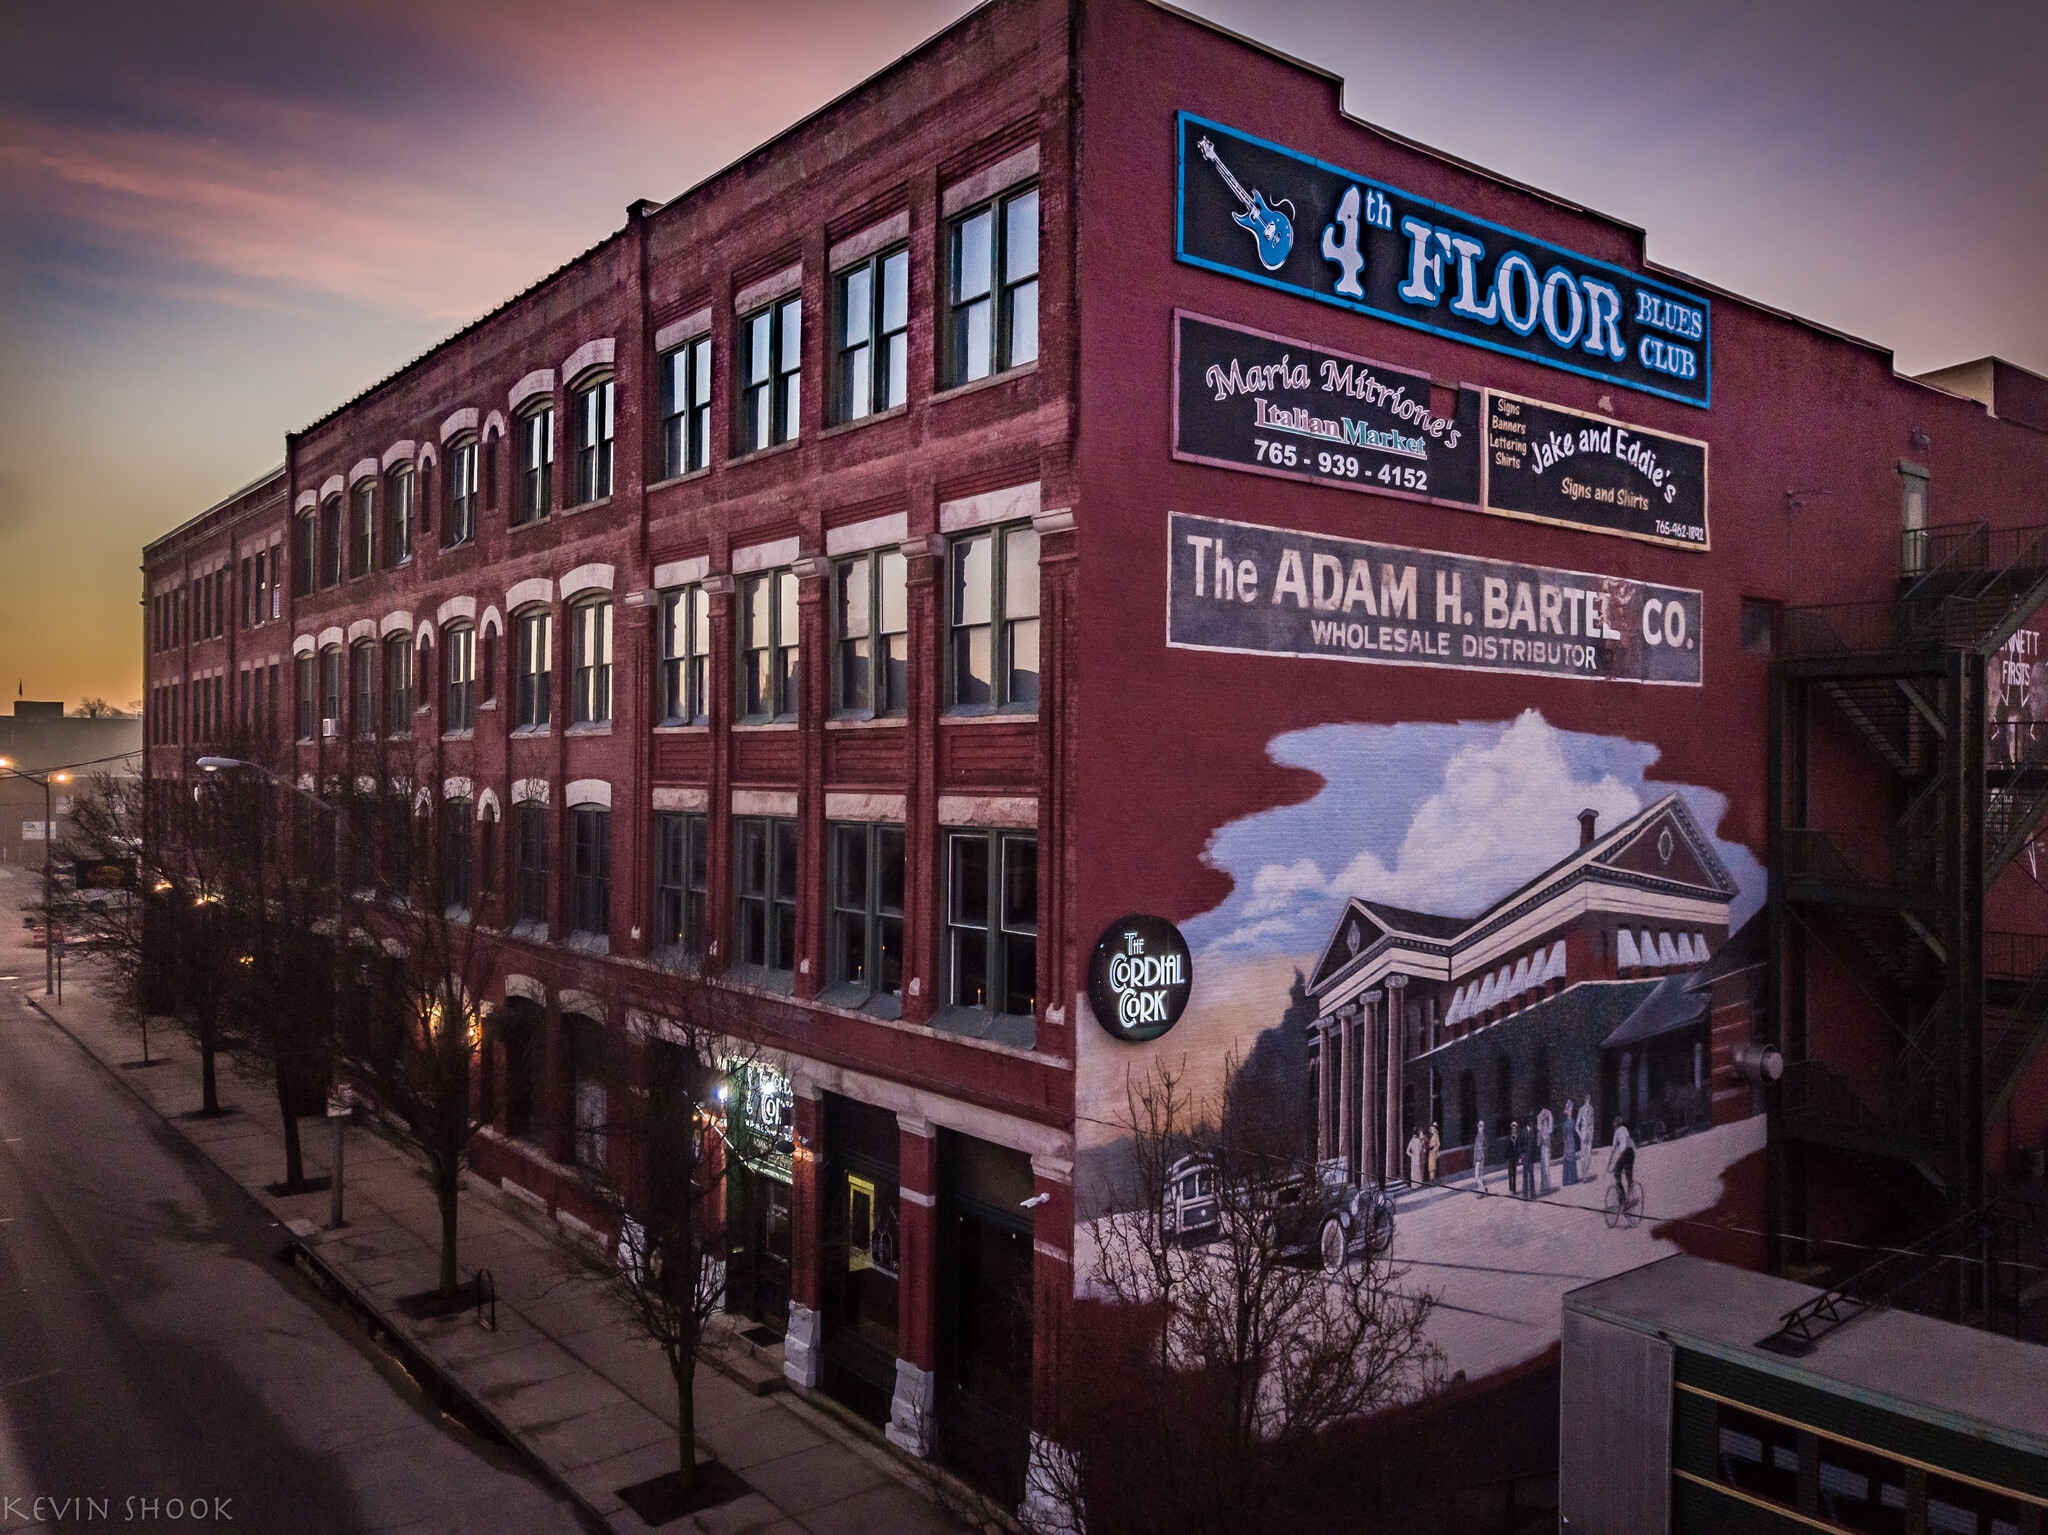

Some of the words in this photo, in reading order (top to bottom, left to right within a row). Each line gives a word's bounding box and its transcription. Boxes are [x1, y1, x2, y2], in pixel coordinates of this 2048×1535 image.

[1321, 185, 1392, 298] 4th
[1401, 217, 1625, 359] FLOOR
[1635, 290, 1702, 339] BLUES
[1640, 336, 1696, 378] CLUB
[1205, 354, 1311, 401] Maria
[1320, 359, 1462, 450] Mitrione's
[1497, 399, 1520, 416] Signs
[1254, 398, 1340, 437] Italian
[1341, 416, 1426, 456] Market
[1489, 434, 1527, 456] Lettering
[1491, 415, 1526, 434] Banners
[1495, 451, 1521, 469] Shirts
[1531, 431, 1574, 475] Jake
[1579, 426, 1611, 455] and
[1615, 429, 1677, 504] Eddie's
[1561, 477, 1592, 501] Signs
[1594, 487, 1614, 504] and
[1616, 488, 1649, 511] Shirts
[1655, 519, 1705, 541] 765-962-1892
[1187, 534, 1258, 603] The
[1271, 548, 1418, 620] ADAM
[1436, 569, 1473, 626] H.
[1642, 597, 1694, 650] CO.
[1310, 619, 1451, 657] WHOLESALE
[1462, 633, 1597, 670] DISTRIBUTOR
[2002, 660, 2031, 687] FIRSTS
[1109, 952, 1185, 993] CORDIAL
[1119, 987, 1168, 1028] CORK
